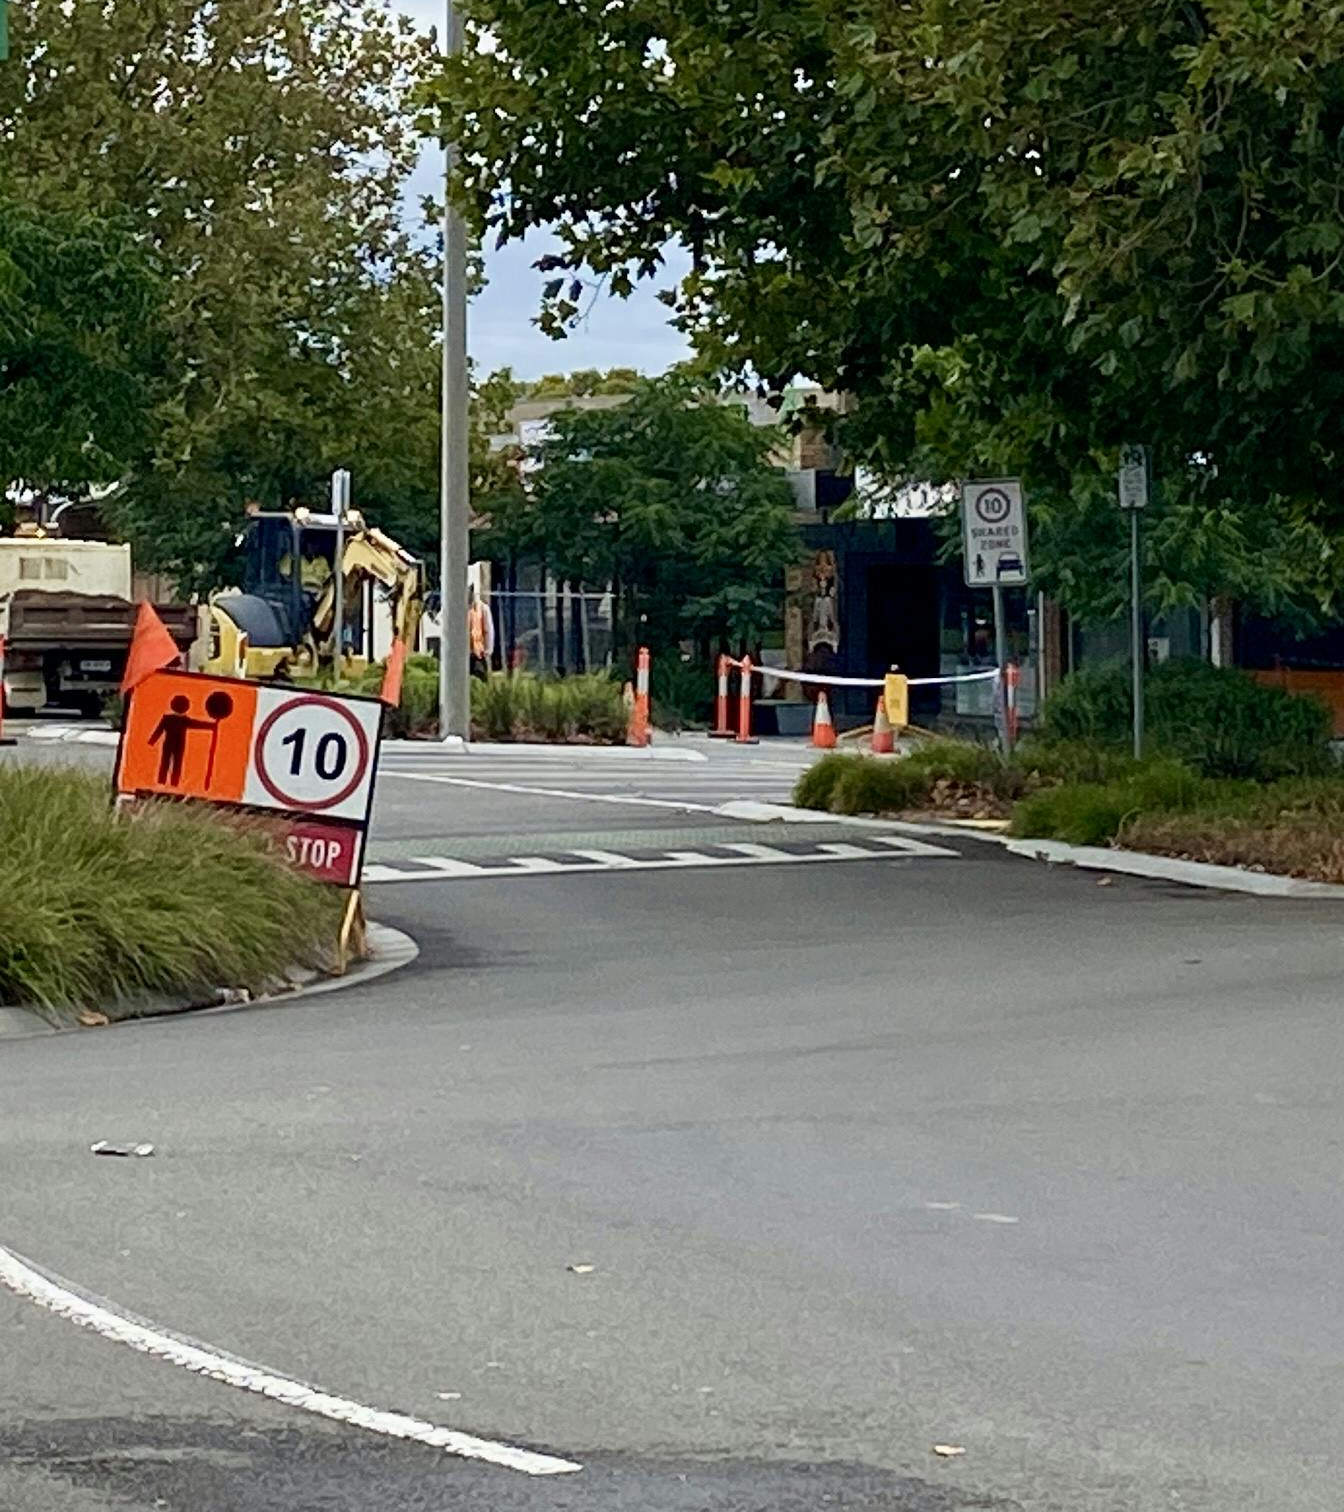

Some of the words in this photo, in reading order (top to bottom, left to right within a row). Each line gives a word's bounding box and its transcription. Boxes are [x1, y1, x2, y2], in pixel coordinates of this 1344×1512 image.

[984, 497, 1002, 514] 10
[971, 525, 1019, 539] SHARED
[282, 727, 348, 781] 10
[285, 834, 342, 869] STOP
